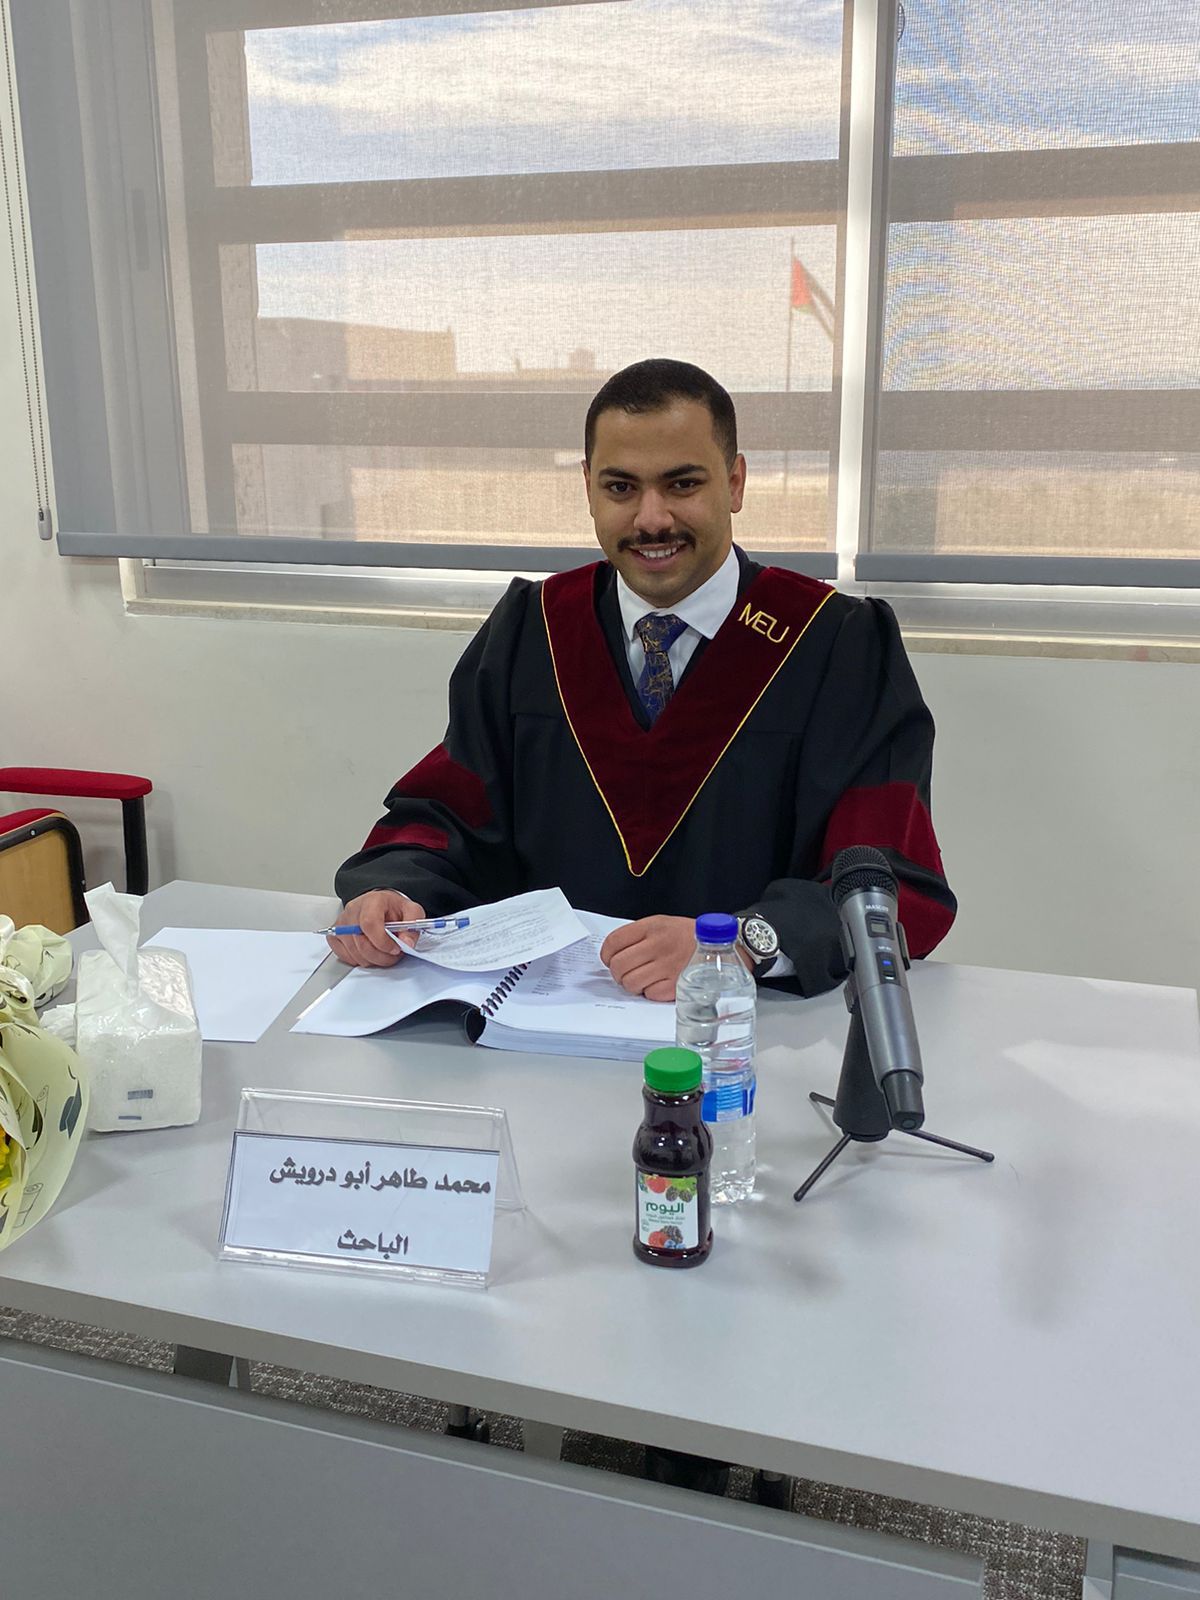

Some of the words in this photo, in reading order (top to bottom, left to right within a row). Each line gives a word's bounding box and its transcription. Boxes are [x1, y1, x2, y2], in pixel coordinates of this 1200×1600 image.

[738, 602, 790, 643] MEU
[269, 1156, 337, 1186] درويش
[339, 1160, 371, 1190] أبو
[370, 1167, 428, 1191] طاهر
[434, 1173, 491, 1194] محمد
[646, 1202, 684, 1216] اليوم
[337, 1228, 409, 1260] الباحث
